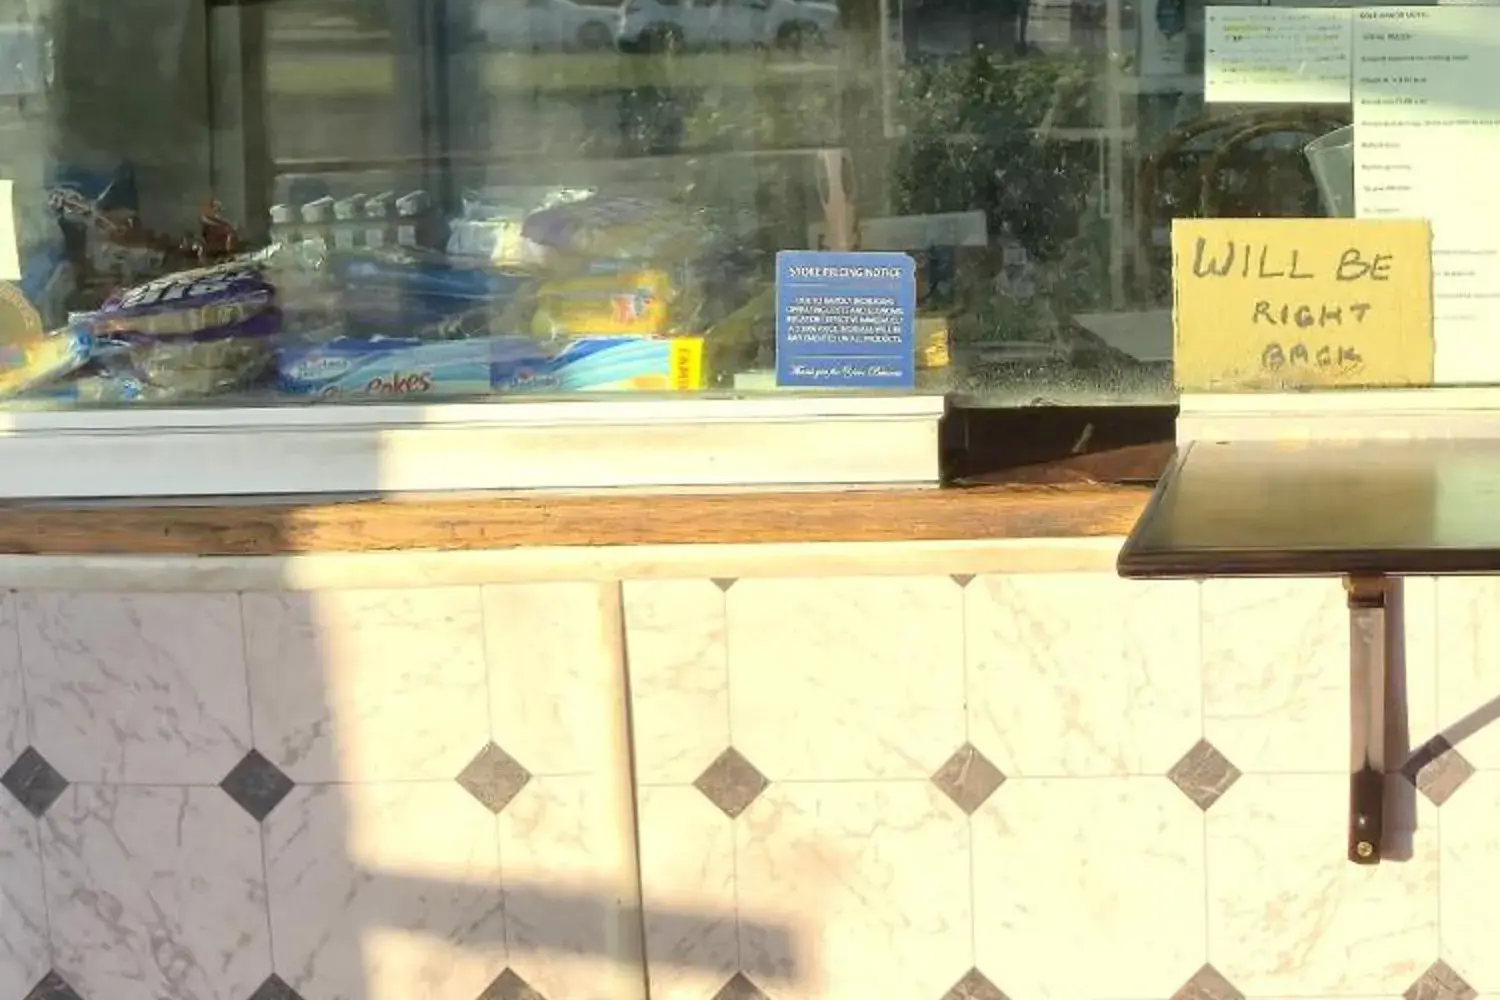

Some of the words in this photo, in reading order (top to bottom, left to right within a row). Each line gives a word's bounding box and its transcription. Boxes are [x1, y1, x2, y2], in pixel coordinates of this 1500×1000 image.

[1193, 237, 1314, 279] WILL
[1336, 248, 1393, 281] BE
[1252, 301, 1371, 328] RIGHT
[1262, 343, 1362, 371] BACK
